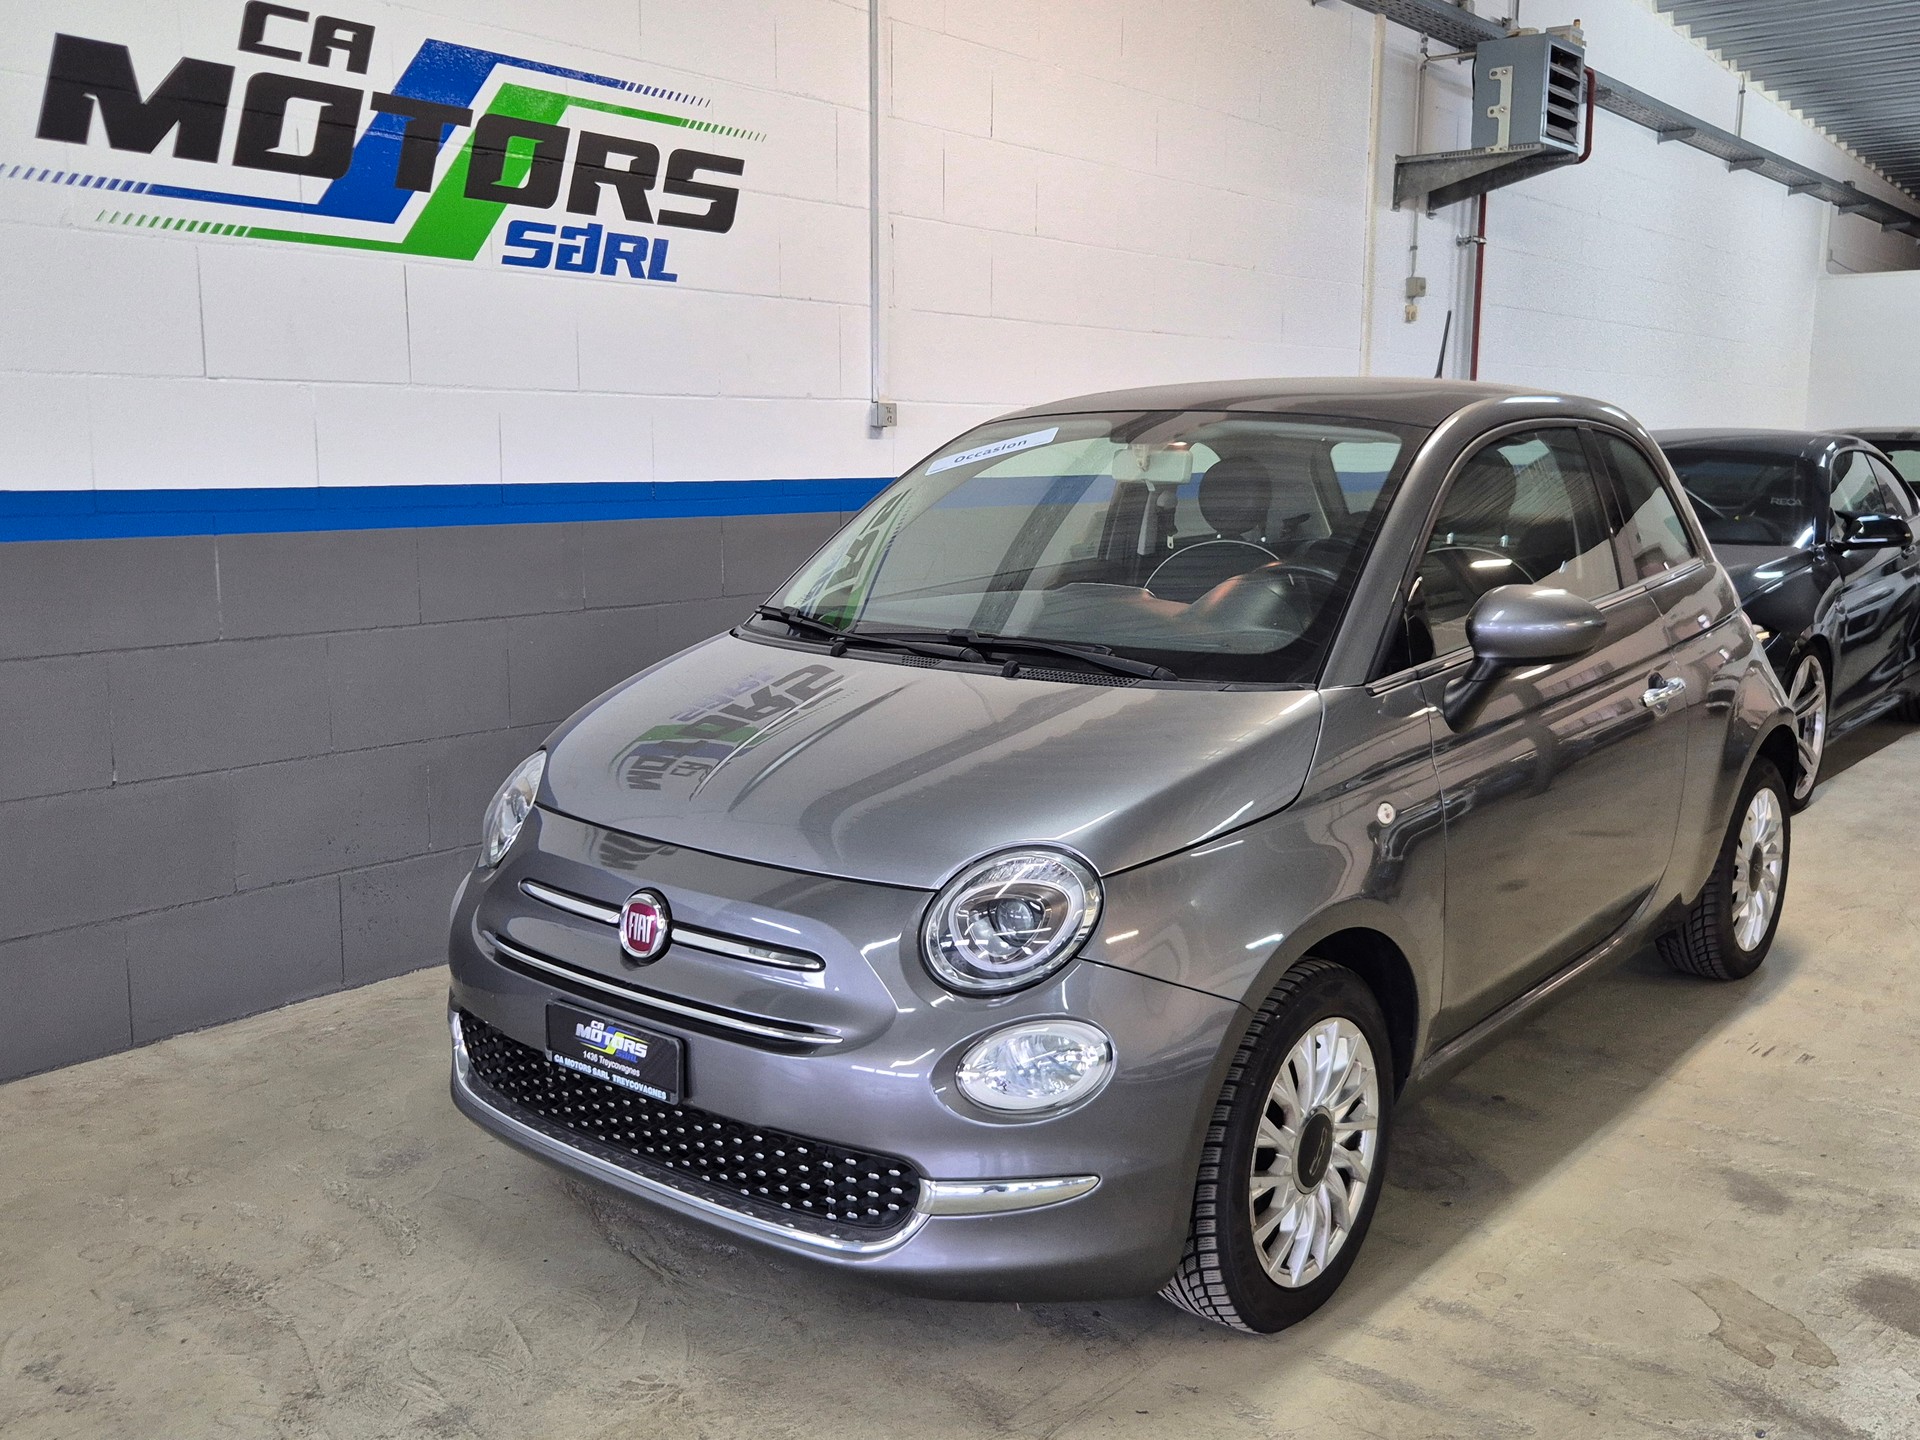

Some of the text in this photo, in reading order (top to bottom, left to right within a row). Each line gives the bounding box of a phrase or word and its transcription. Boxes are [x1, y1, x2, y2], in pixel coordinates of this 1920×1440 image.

[238, 0, 376, 74] CA
[35, 32, 745, 234] MOTORS
[954, 439, 1028, 464] Occasion
[628, 911, 656, 944] FIAT
[575, 1023, 649, 1058] MOTORS
[590, 1020, 605, 1031] CA
[554, 1054, 667, 1100] CA MOTORS SARL TREYCOVAGNES
[599, 1056, 641, 1077] Treycovagnes
